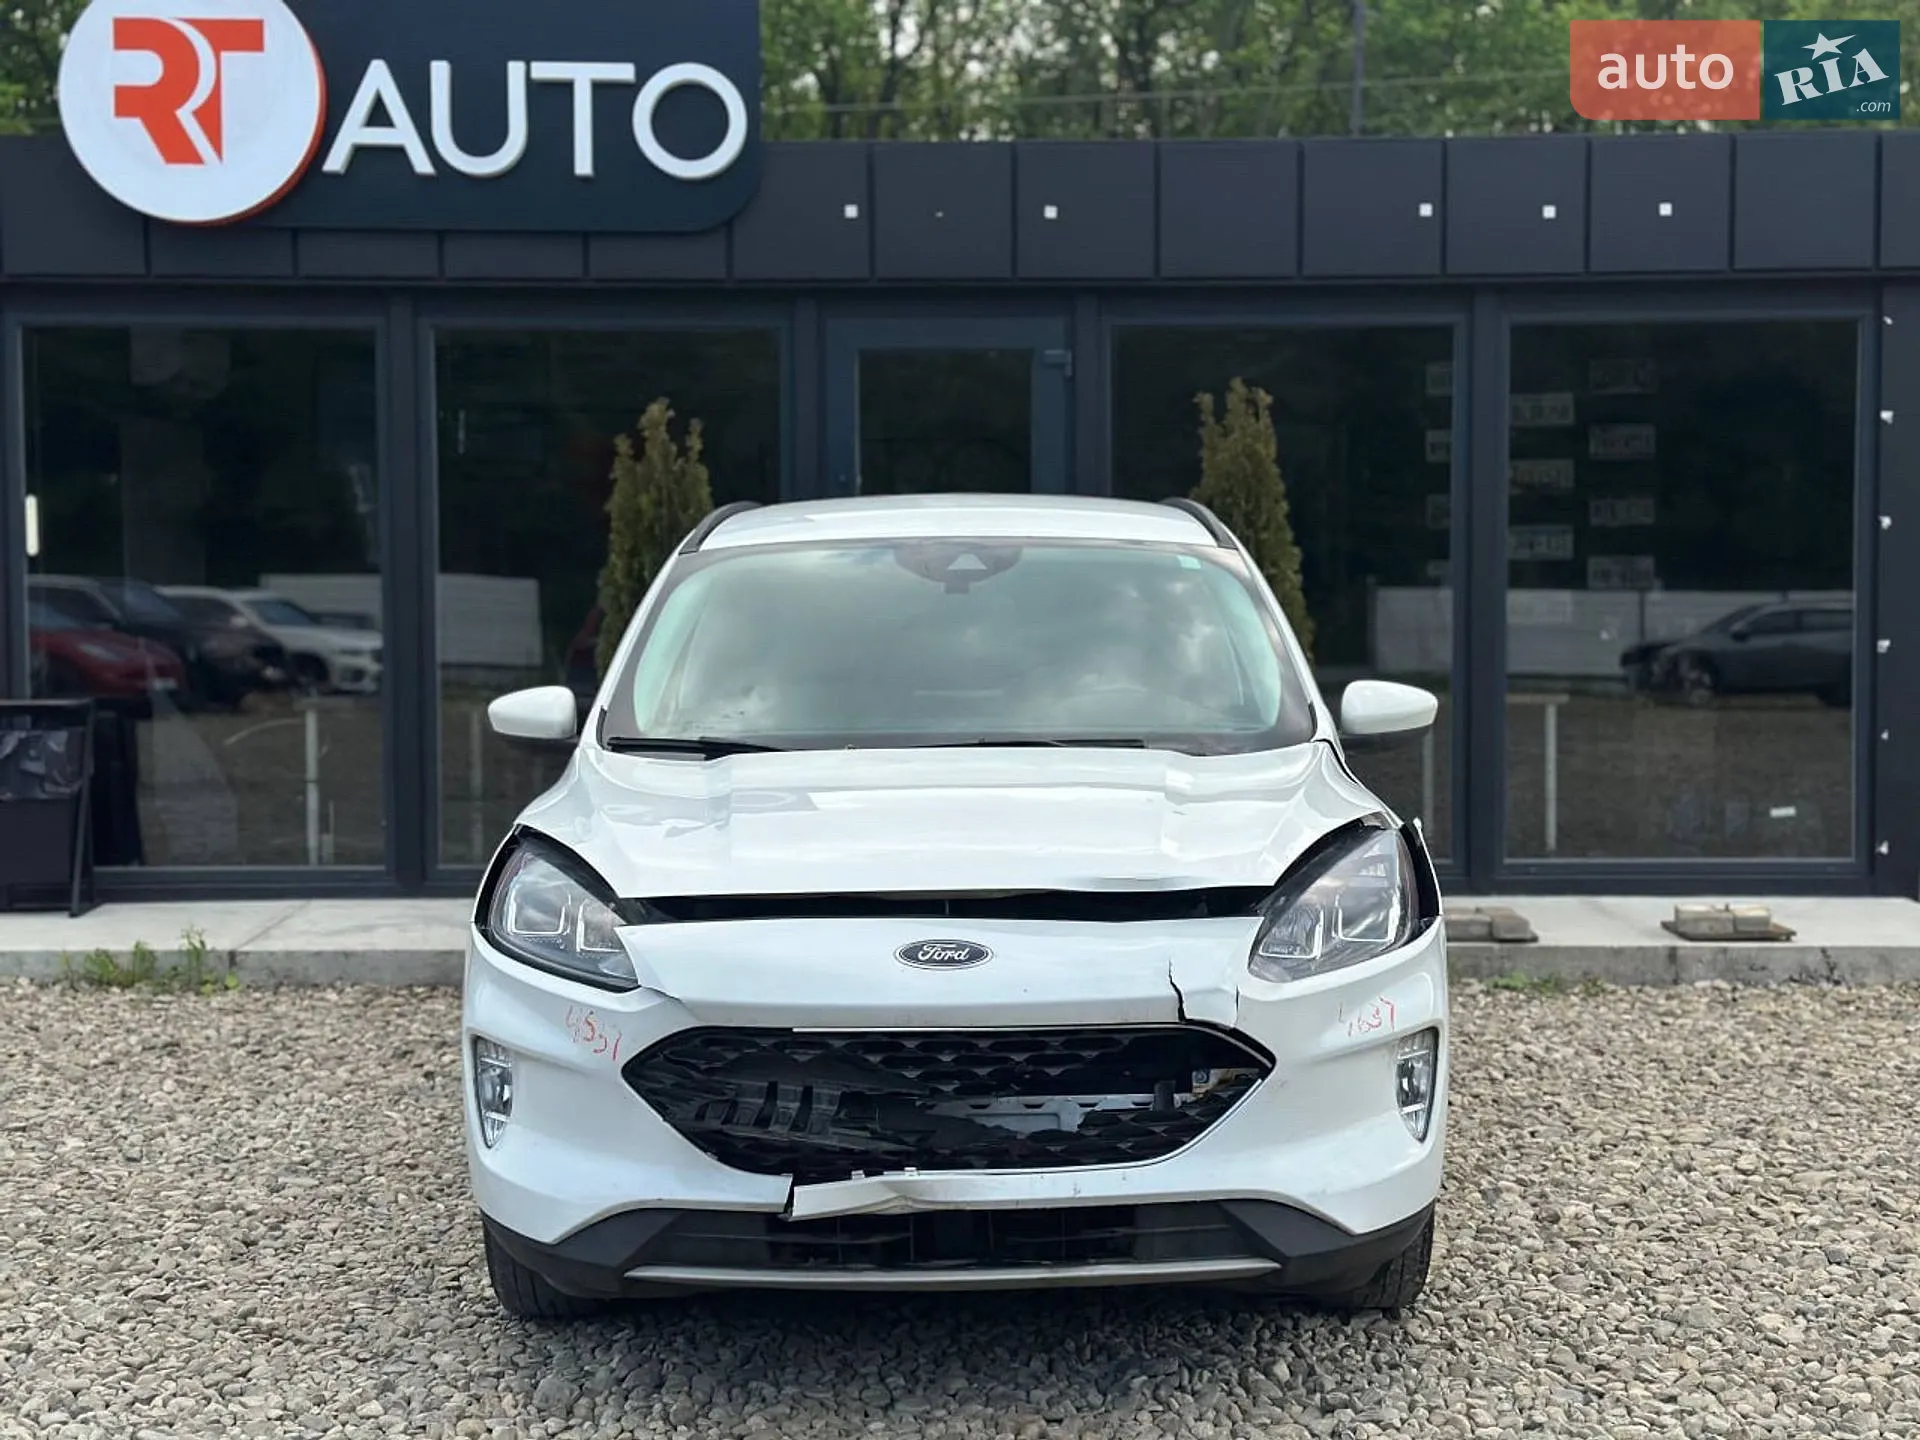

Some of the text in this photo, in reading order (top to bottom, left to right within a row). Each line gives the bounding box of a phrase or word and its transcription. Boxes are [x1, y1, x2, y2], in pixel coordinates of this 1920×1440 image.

[112, 17, 748, 180] RT AUTO
[917, 943, 970, 961] Ford
